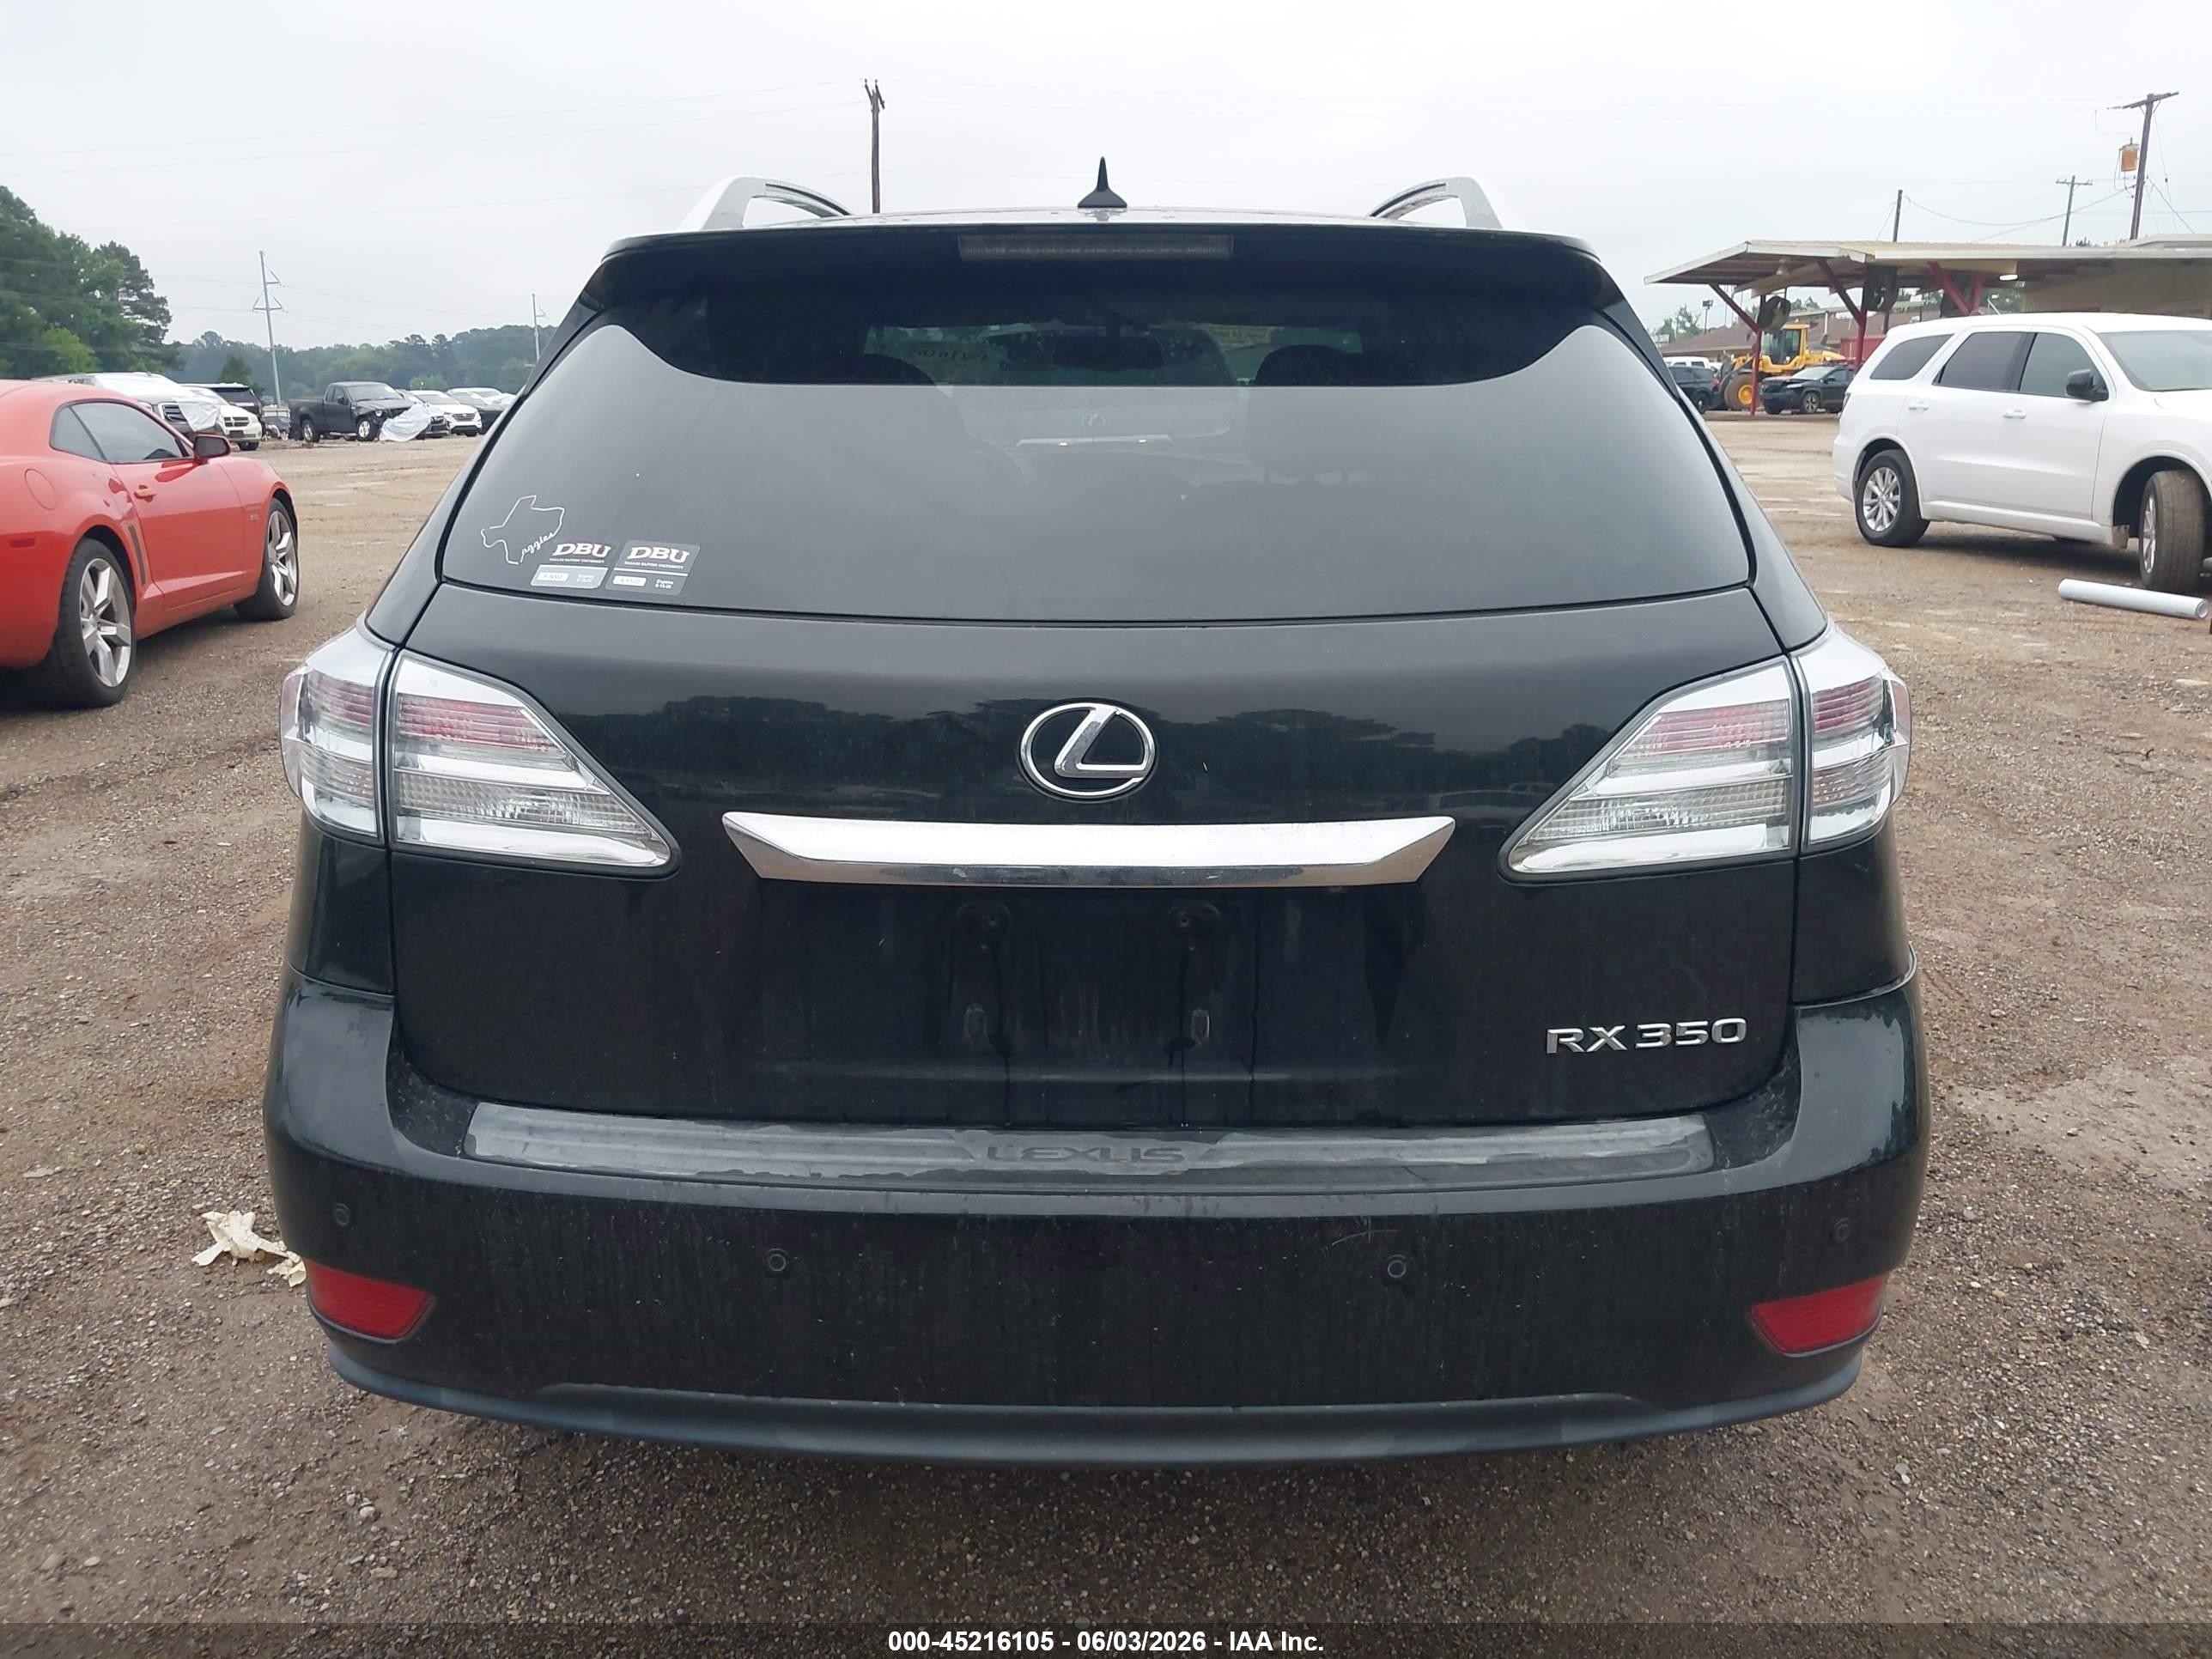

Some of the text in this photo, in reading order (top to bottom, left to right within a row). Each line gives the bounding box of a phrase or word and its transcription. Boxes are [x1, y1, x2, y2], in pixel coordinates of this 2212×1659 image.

[552, 543, 611, 558] DBU
[627, 546, 690, 563] DBU
[1547, 1018, 1747, 1054] RX 350
[988, 1146, 1186, 1164] LEXUS
